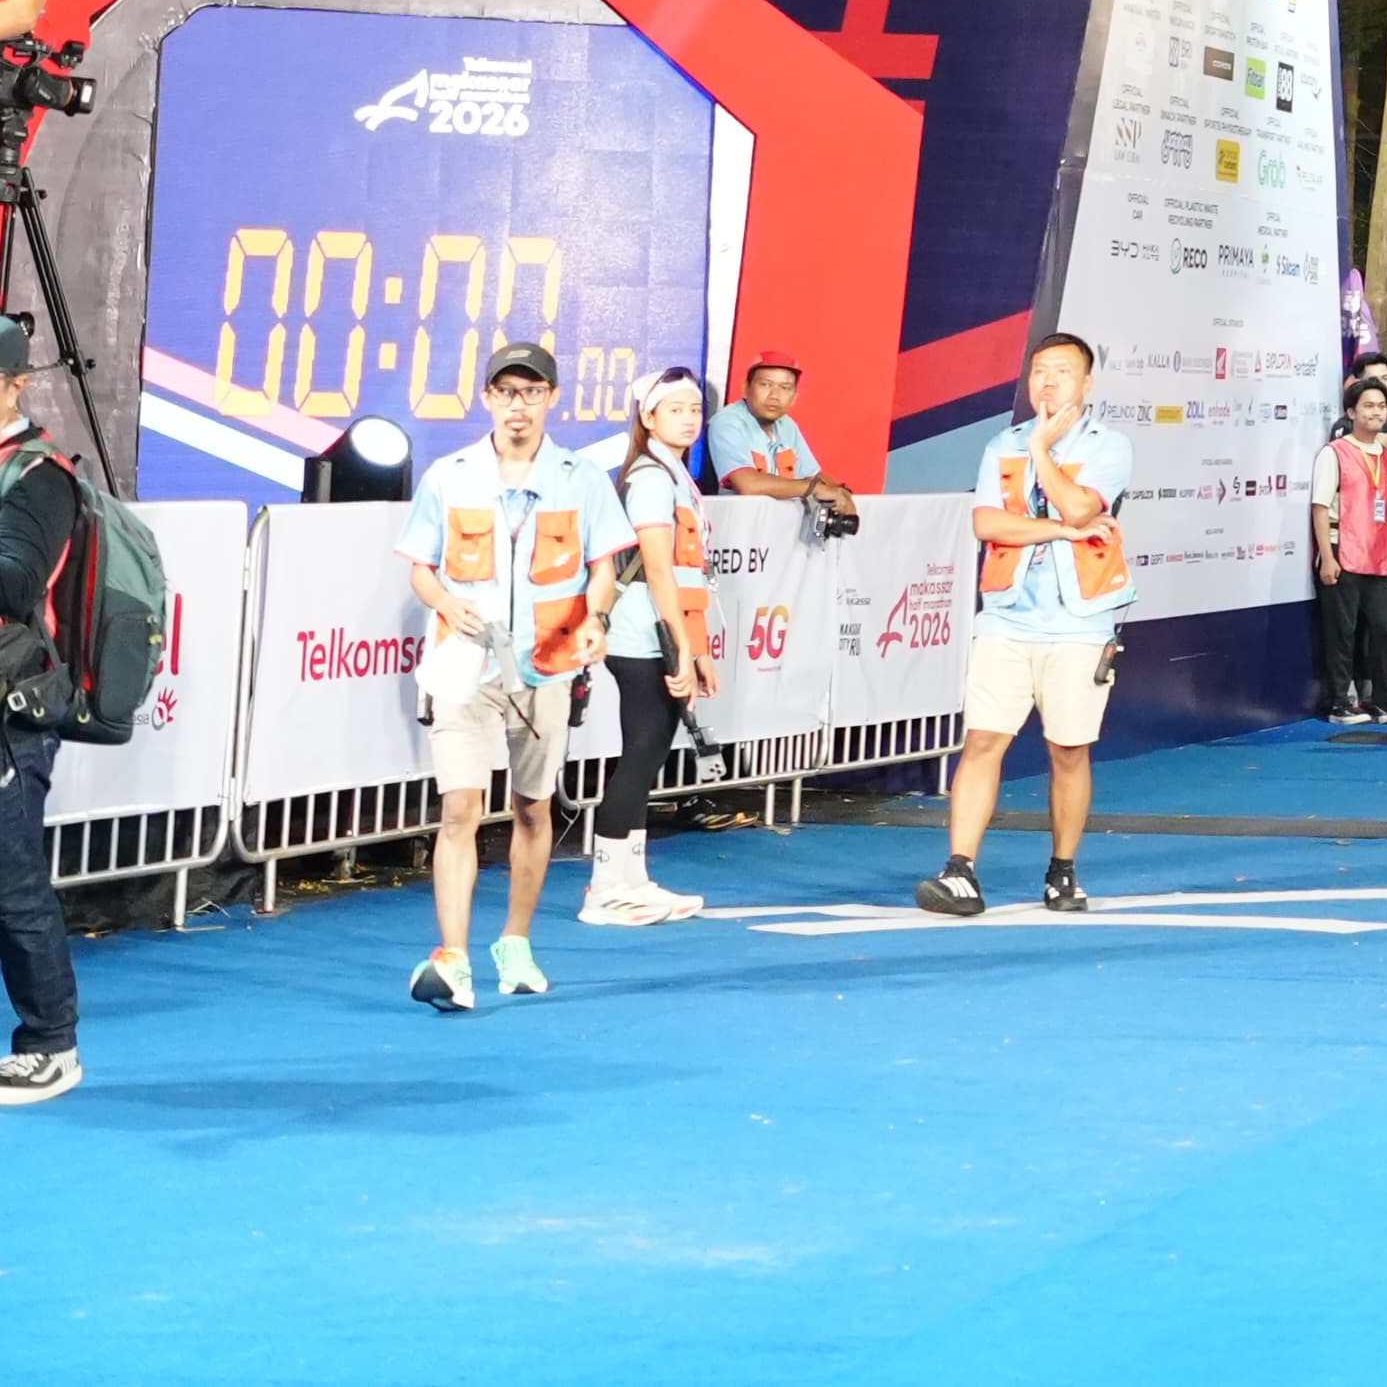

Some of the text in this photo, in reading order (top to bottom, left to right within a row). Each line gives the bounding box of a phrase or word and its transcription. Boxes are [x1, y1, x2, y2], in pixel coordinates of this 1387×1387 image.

[429, 100, 530, 137] 2026
[1257, 149, 1287, 190] Grab
[1183, 247, 1208, 269] RECO
[1218, 244, 1254, 267] PRIMAYA
[748, 547, 769, 573] BY
[910, 580, 953, 595] makassar
[744, 605, 790, 660] 5G
[909, 611, 951, 648] 2026
